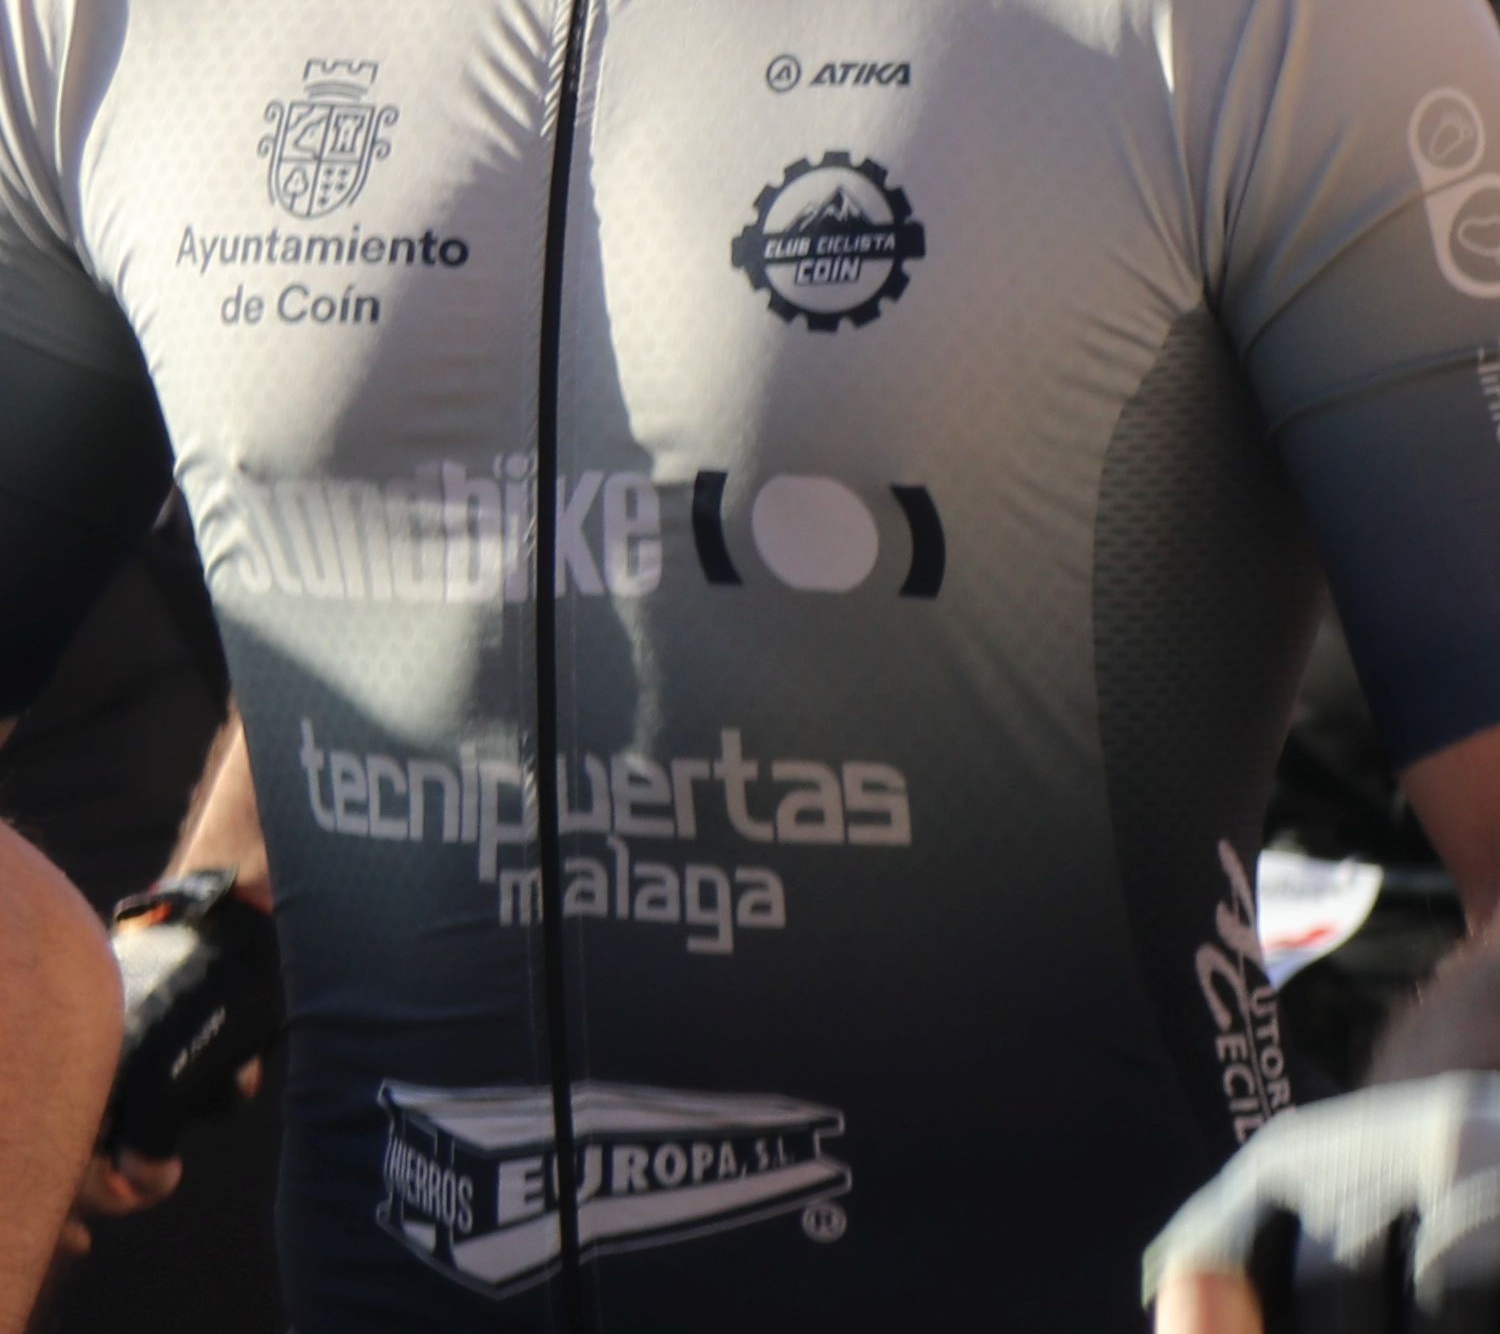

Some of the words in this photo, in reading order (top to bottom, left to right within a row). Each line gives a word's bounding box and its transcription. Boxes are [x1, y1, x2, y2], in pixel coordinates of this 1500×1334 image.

[809, 62, 912, 87] ATIKA
[176, 224, 470, 275] Ayuntamiento
[763, 237, 811, 259] CLUB
[816, 232, 896, 254] CICLISTA
[220, 284, 264, 324] de
[277, 282, 381, 324] Coín
[300, 718, 912, 884] tecnipuertas
[499, 835, 787, 955] malaga
[1216, 838, 1297, 1113] AUTOR
